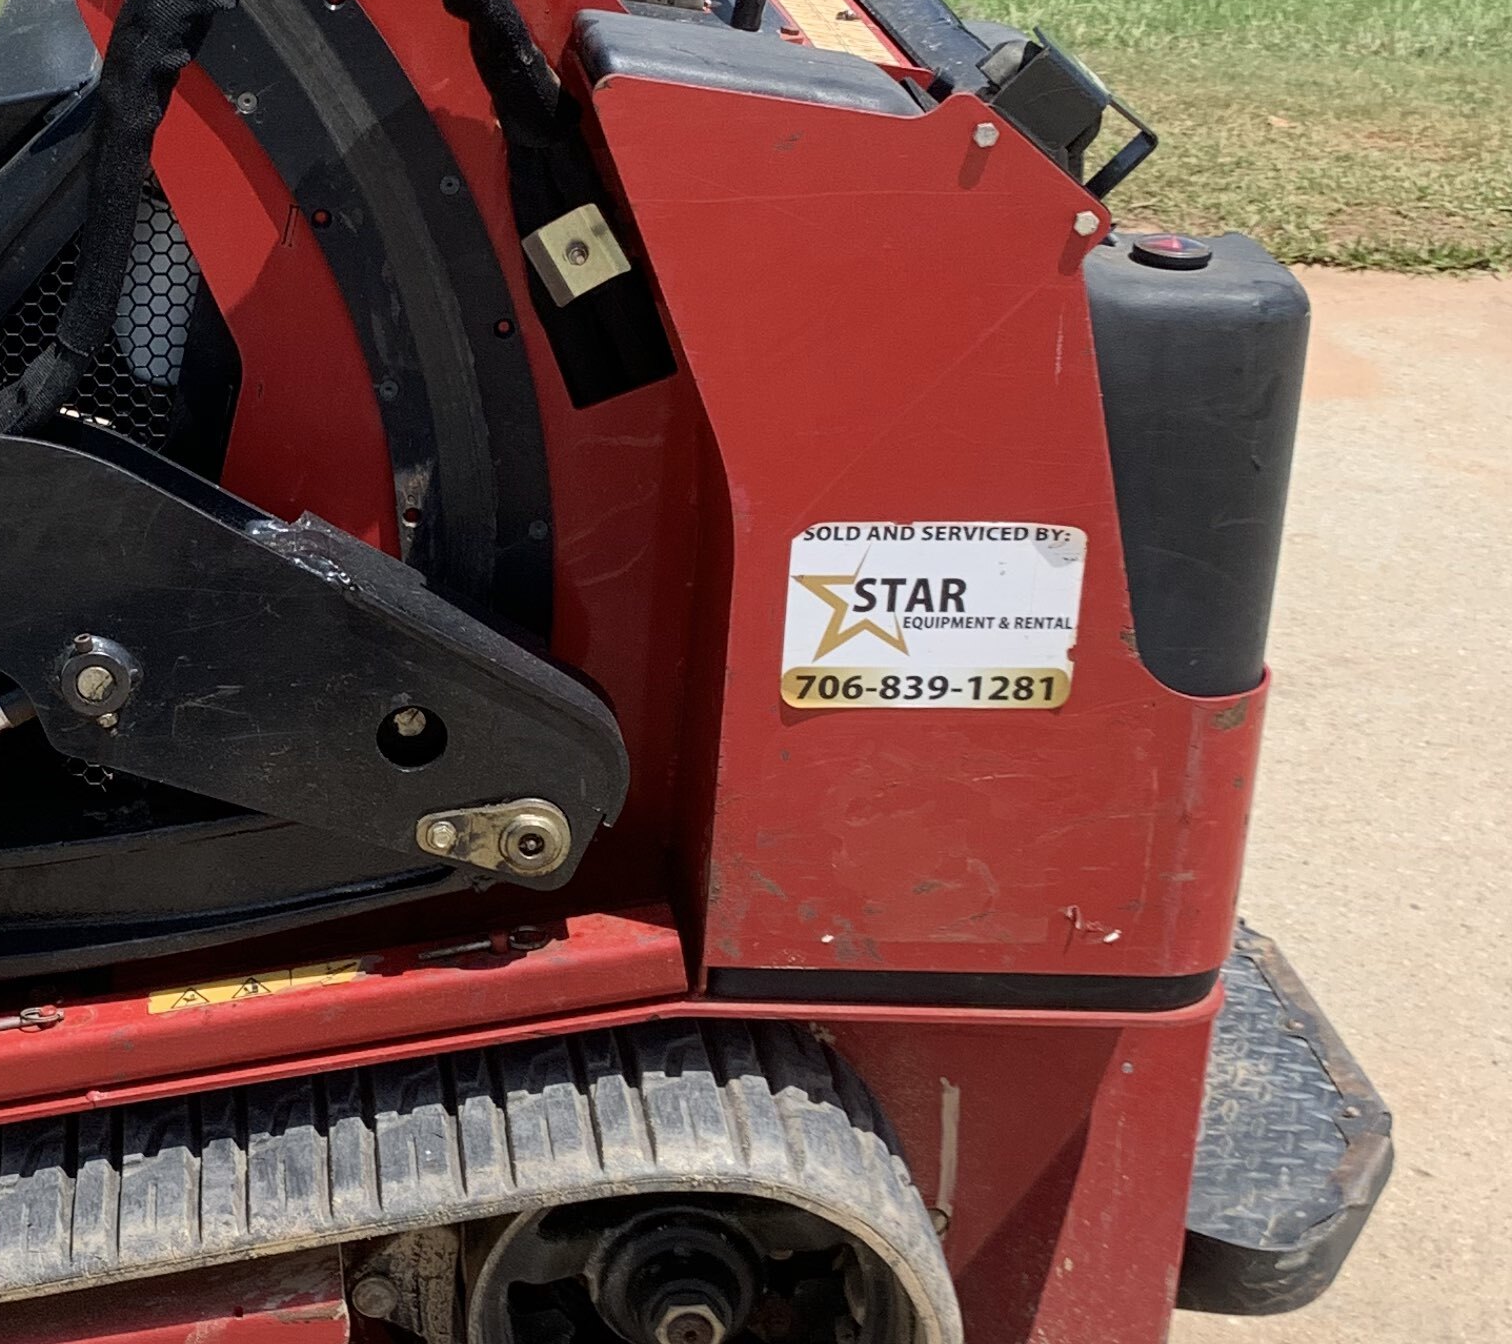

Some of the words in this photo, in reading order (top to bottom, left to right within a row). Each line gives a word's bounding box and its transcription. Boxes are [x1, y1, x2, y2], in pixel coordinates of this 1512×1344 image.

[802, 525, 861, 542] SOLD
[866, 525, 916, 542] AND
[920, 525, 1029, 542] SERVICED
[1035, 526, 1071, 542] BY:
[852, 577, 967, 613] STAR
[902, 615, 996, 630] EQUIPMENT
[998, 616, 1010, 630] &
[1013, 616, 1074, 631] RENTAL
[795, 674, 1056, 702] 706-839-1281
